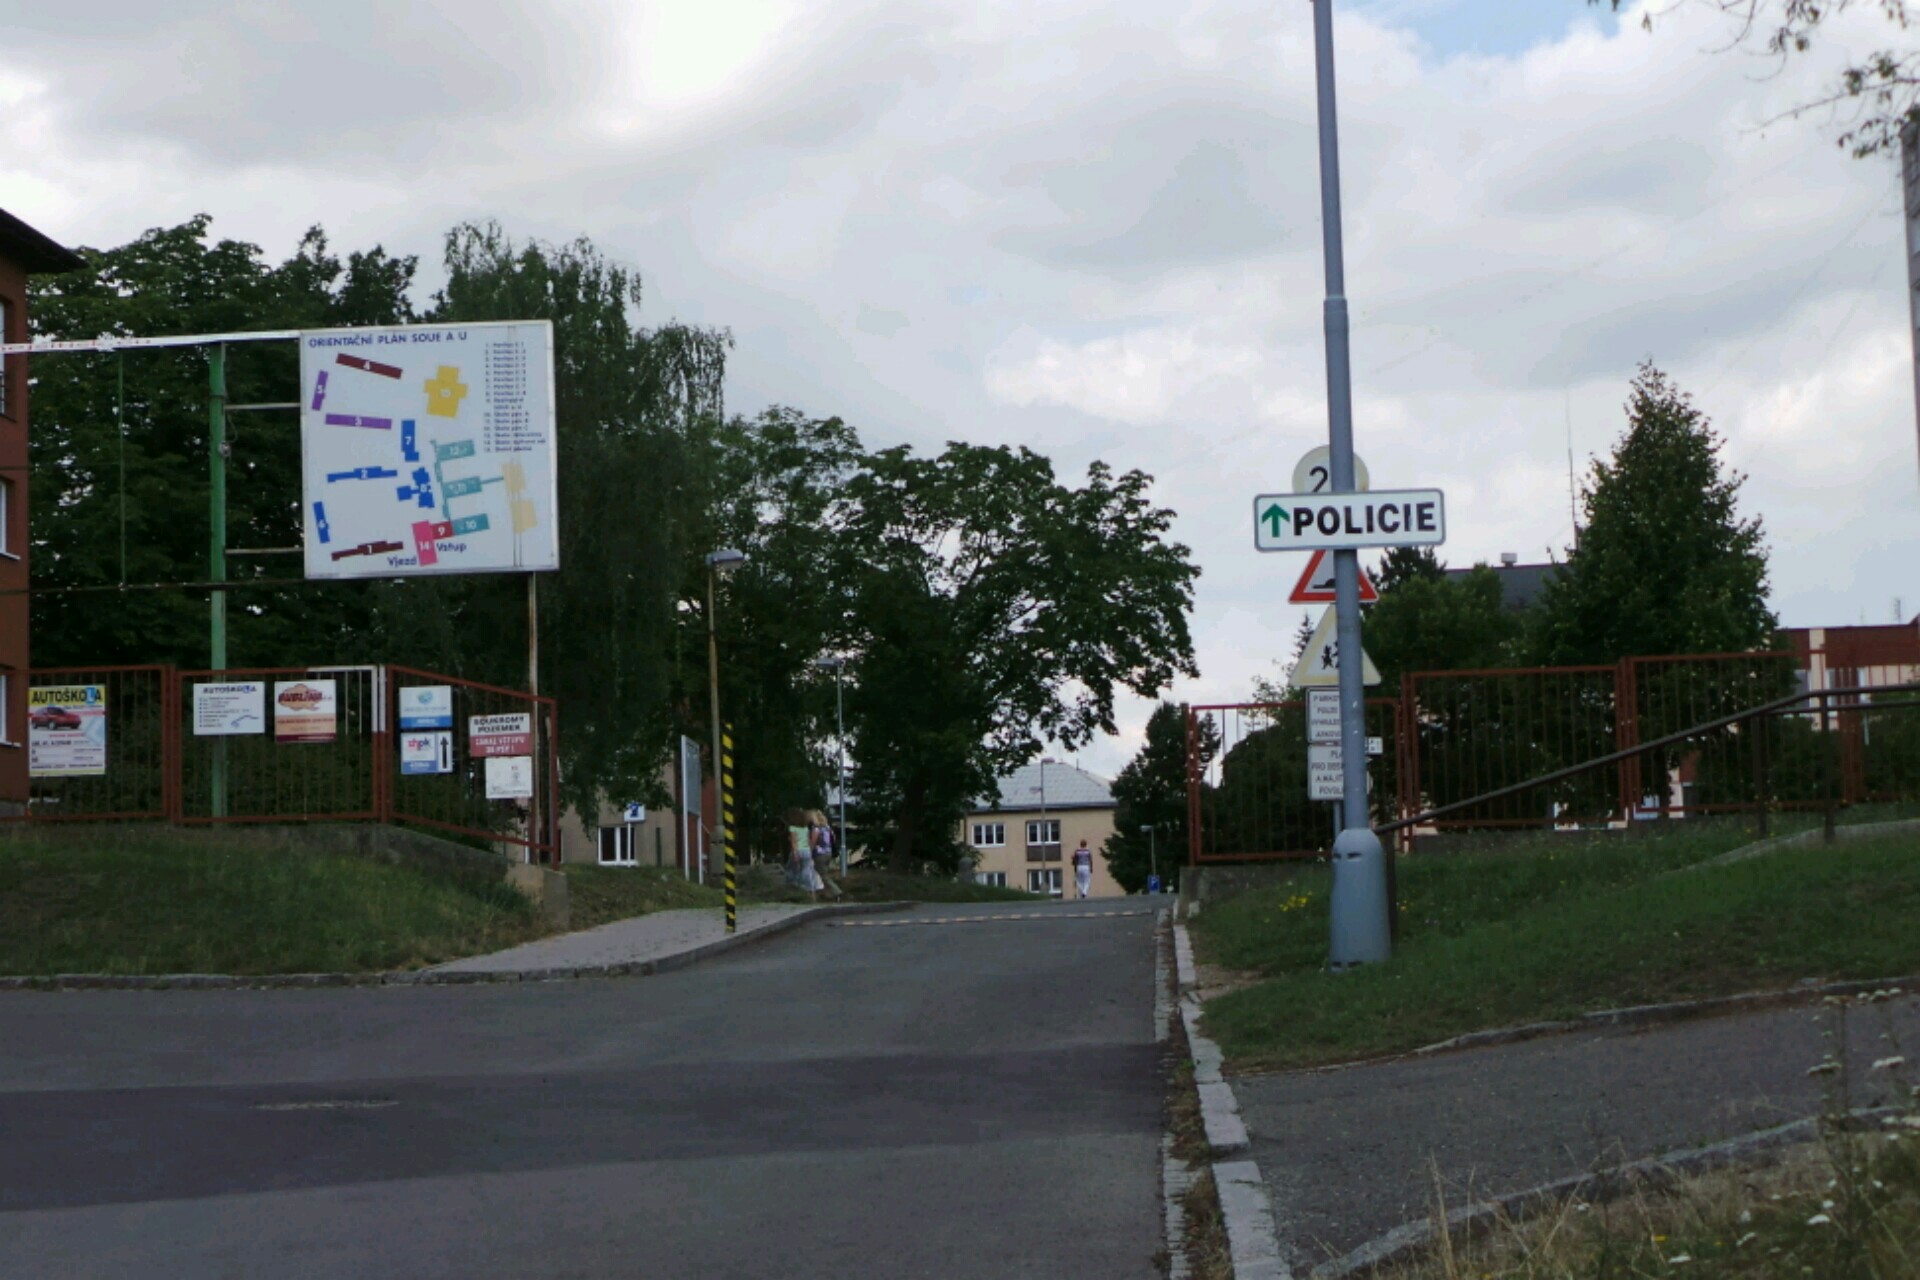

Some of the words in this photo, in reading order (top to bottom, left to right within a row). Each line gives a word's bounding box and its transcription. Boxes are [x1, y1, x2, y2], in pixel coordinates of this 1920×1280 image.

[308, 333, 373, 348] ORIENTAČNÍ
[363, 360, 371, 371] 4
[404, 436, 411, 445] 7
[1293, 502, 1437, 536] POLICIE
[438, 526, 445, 536] 9
[436, 541, 467, 554] Vstup
[387, 555, 417, 567] Vjezd
[31, 687, 102, 705] AUTOŠKOLA
